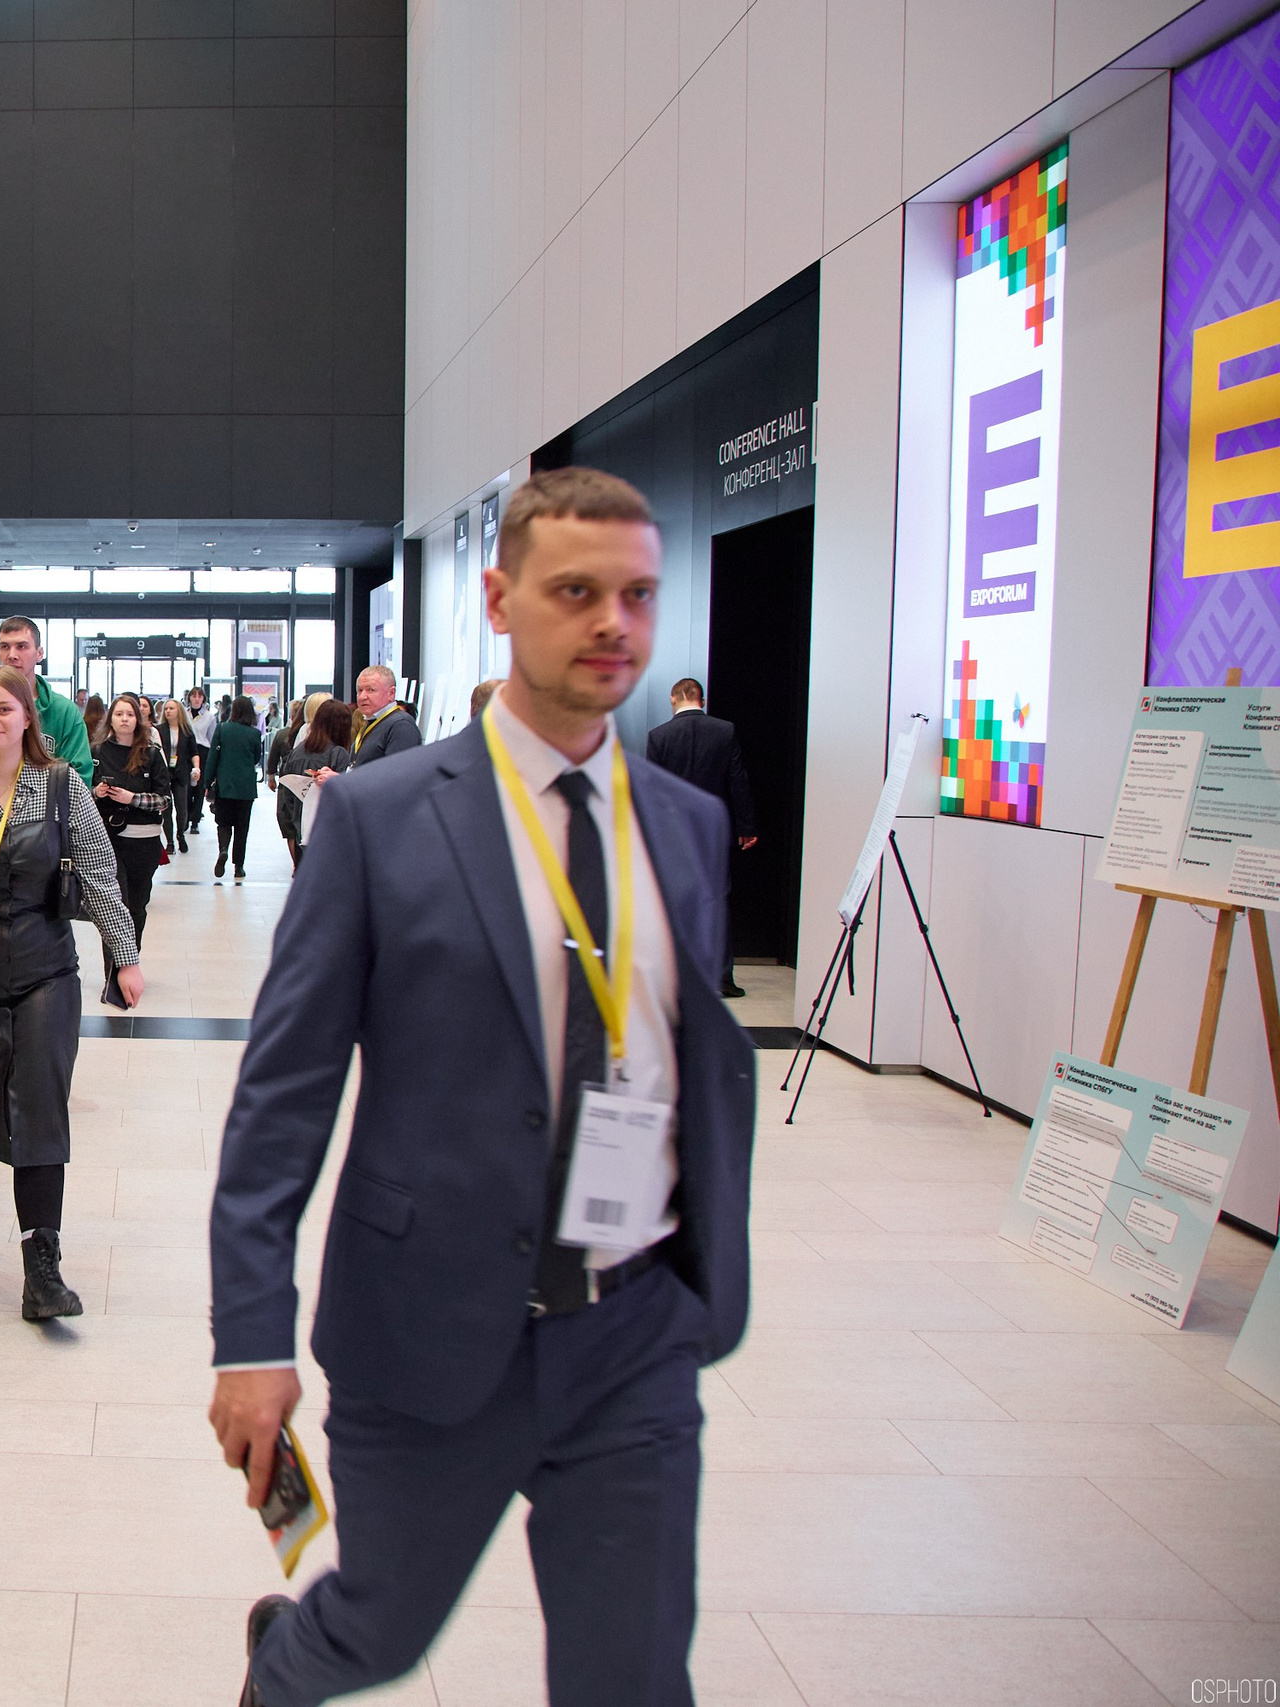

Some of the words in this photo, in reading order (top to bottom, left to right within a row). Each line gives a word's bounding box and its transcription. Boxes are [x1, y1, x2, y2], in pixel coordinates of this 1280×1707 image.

[719, 419, 778, 465] CONFERENCE
[779, 407, 807, 440] HALL
[723, 444, 806, 497] КОНФЕРЕНЦ-ЗАЛ
[970, 582, 1028, 607] EXPOFORUM
[137, 640, 145, 650] 9
[175, 640, 202, 648] ENTRANCE
[1155, 696, 1227, 704] Конфликтологическая
[1153, 705, 1180, 713] Клиника
[1247, 703, 1271, 713] Услуги
[1242, 723, 1272, 732] Клиники
[1066, 1074, 1093, 1089] Клиника
[1069, 1065, 1138, 1093] Конфликтологическая
[1154, 1094, 1173, 1106] Когда
[1172, 1101, 1184, 1110] вас
[1193, 1108, 1223, 1123] слушают,
[1223, 1118, 1233, 1126] не
[1148, 1113, 1171, 1125] кричат
[1151, 1104, 1183, 1119] понимают
[1183, 1115, 1196, 1124] или
[1196, 1119, 1205, 1127] на
[1205, 1122, 1217, 1131] вас
